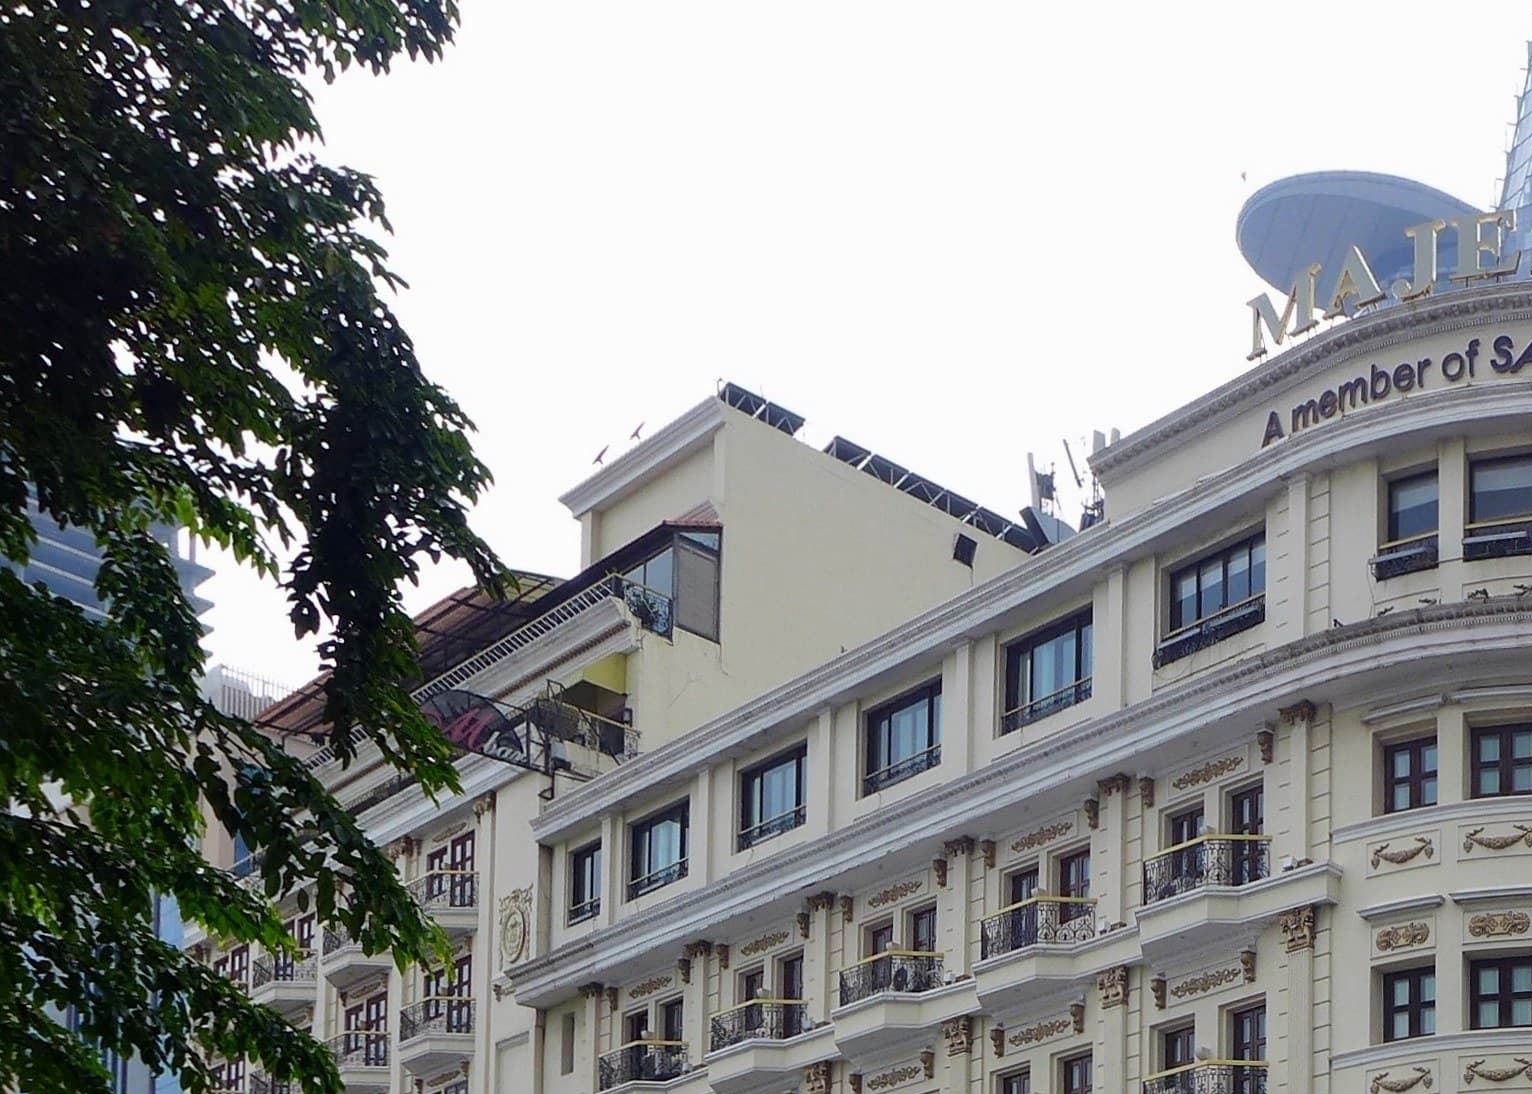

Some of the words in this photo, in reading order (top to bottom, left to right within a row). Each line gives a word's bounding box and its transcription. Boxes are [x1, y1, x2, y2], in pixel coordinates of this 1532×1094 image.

[1262, 411, 1285, 448] A
[1291, 358, 1432, 433] member
[1442, 338, 1480, 381] of
